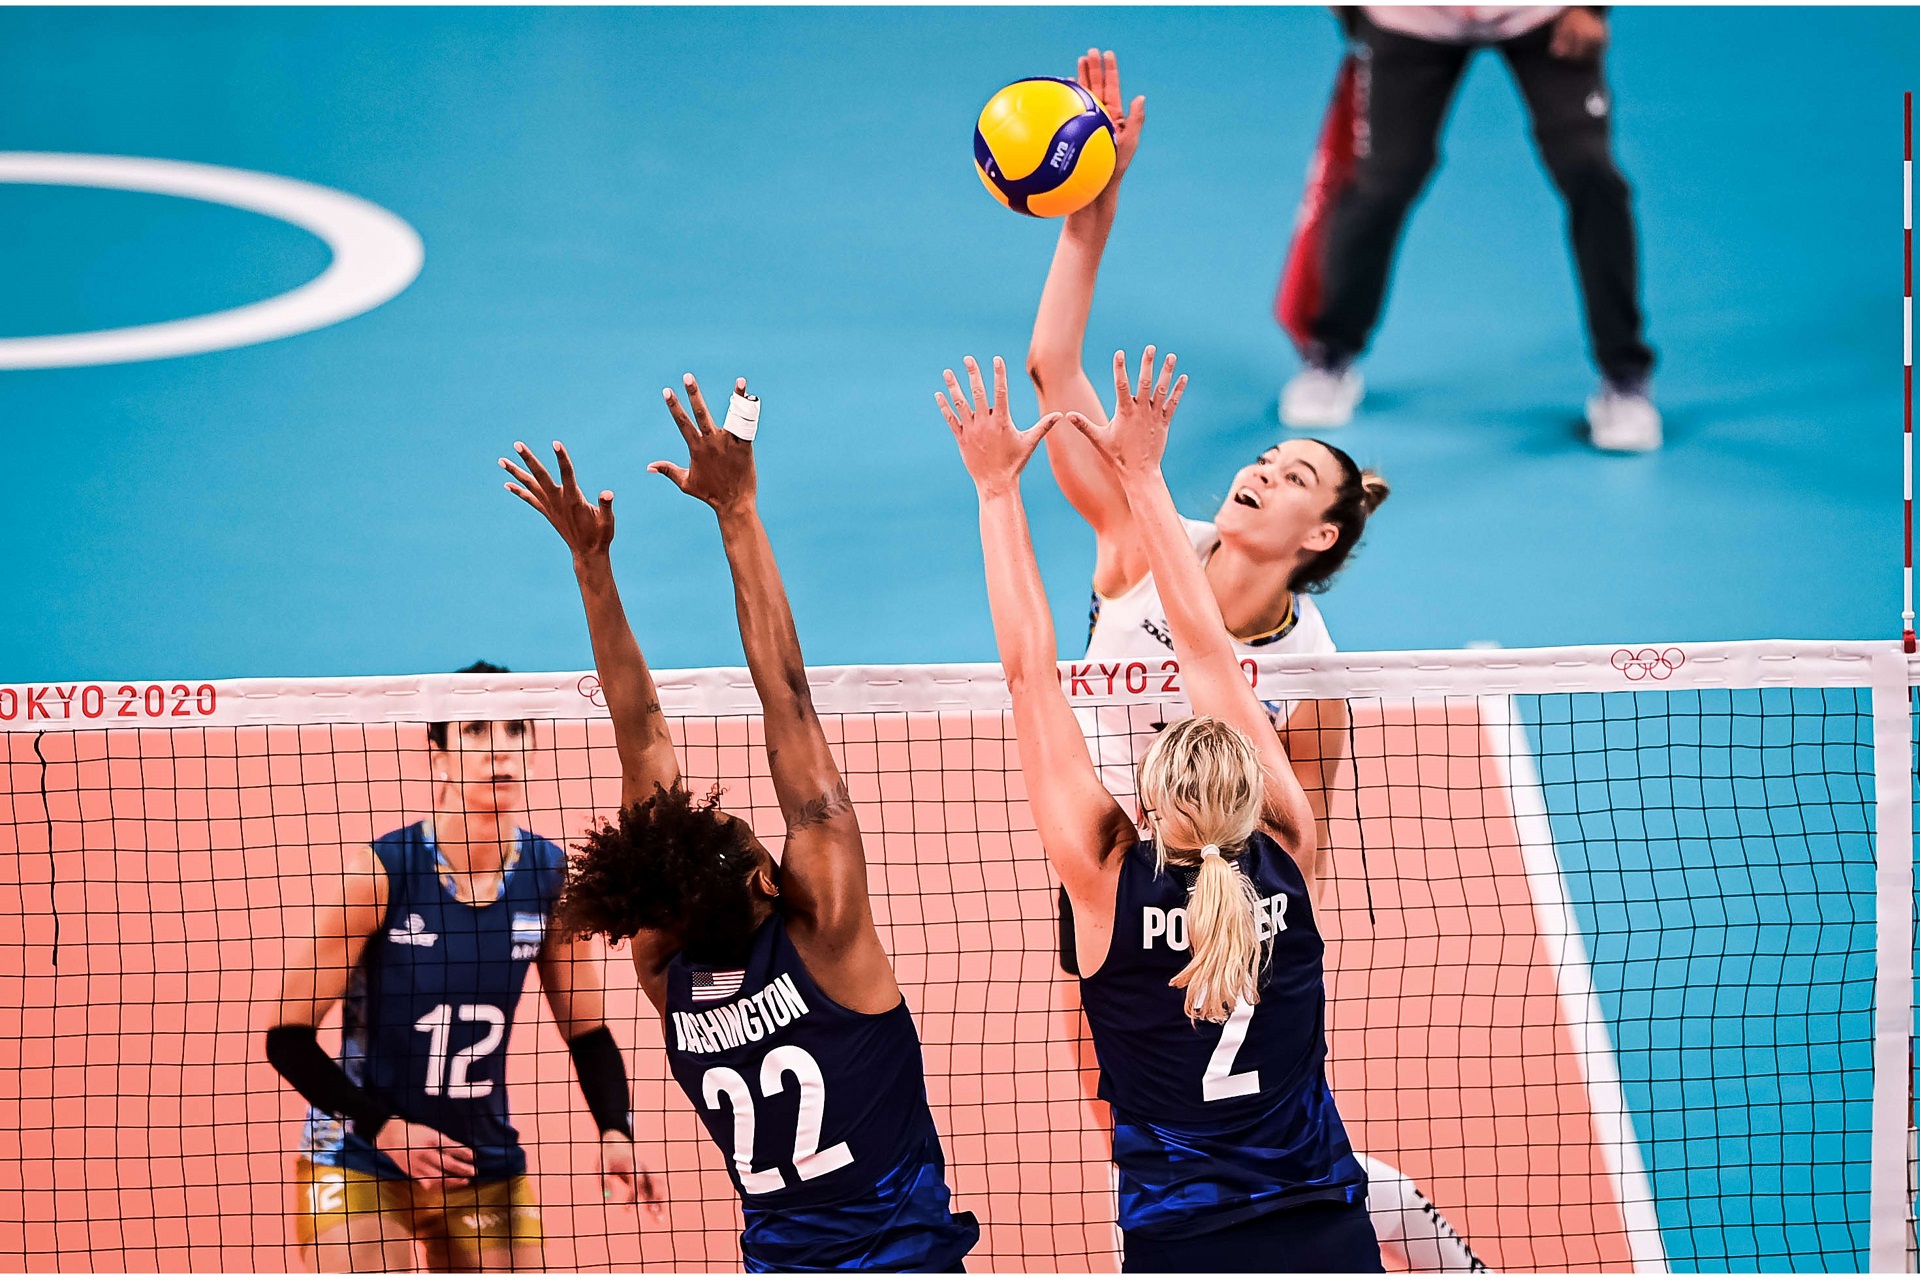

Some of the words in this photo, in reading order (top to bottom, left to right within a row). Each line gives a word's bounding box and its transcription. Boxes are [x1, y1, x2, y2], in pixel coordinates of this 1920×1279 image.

[1050, 141, 1069, 169] FIVB
[117, 683, 217, 718] 2020
[1057, 661, 1148, 696] KYO
[1160, 658, 1258, 693] 20
[1142, 892, 1289, 952] POER
[413, 1003, 506, 1099] 12
[1193, 975, 1261, 1102] 2
[702, 1045, 855, 1195] 22
[307, 1173, 345, 1215] 12
